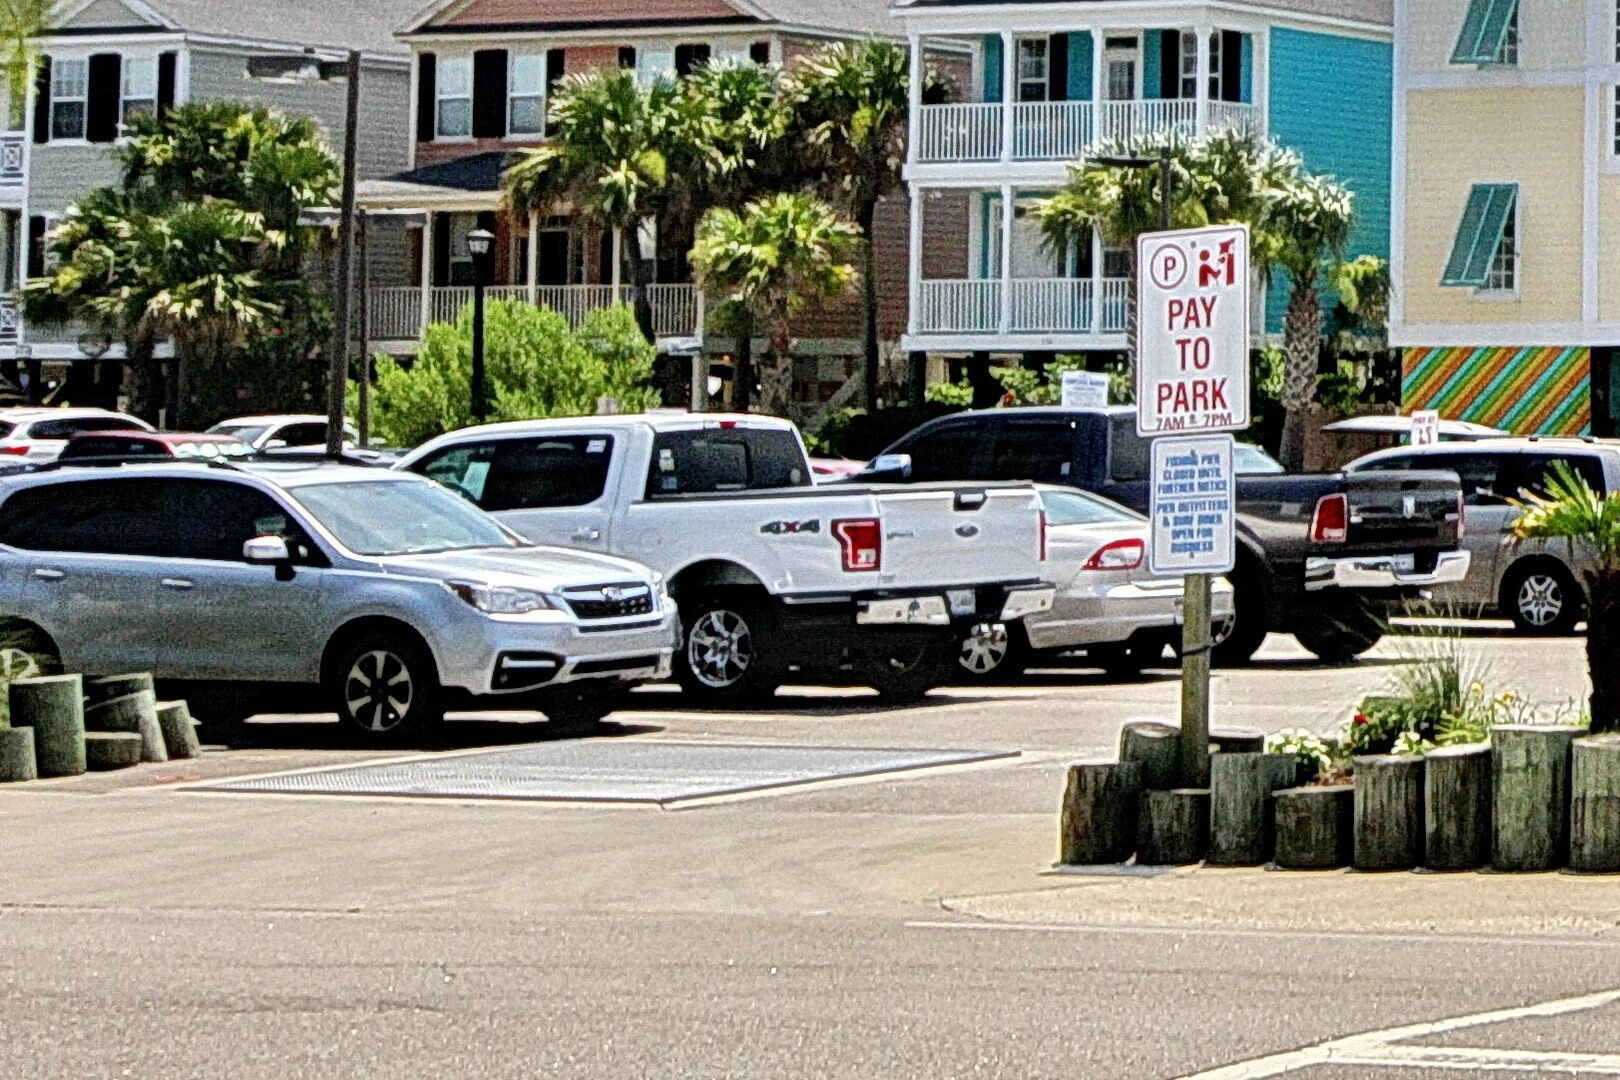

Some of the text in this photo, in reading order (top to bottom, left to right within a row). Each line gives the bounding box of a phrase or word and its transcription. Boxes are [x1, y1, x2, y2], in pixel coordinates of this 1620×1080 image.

[1163, 256, 1176, 281] P
[1168, 295, 1217, 331] PAY
[1175, 336, 1210, 371] TO
[1157, 377, 1228, 414] PARK
[1156, 416, 1185, 431] 7AM
[1203, 413, 1232, 427] 7PM
[1163, 467, 1220, 480] CLOSED UNTIL
[1158, 480, 1227, 494] FURTHER NOTICE
[1178, 500, 1228, 512] OUTFITTERS
[1172, 528, 1194, 539] OPEN
